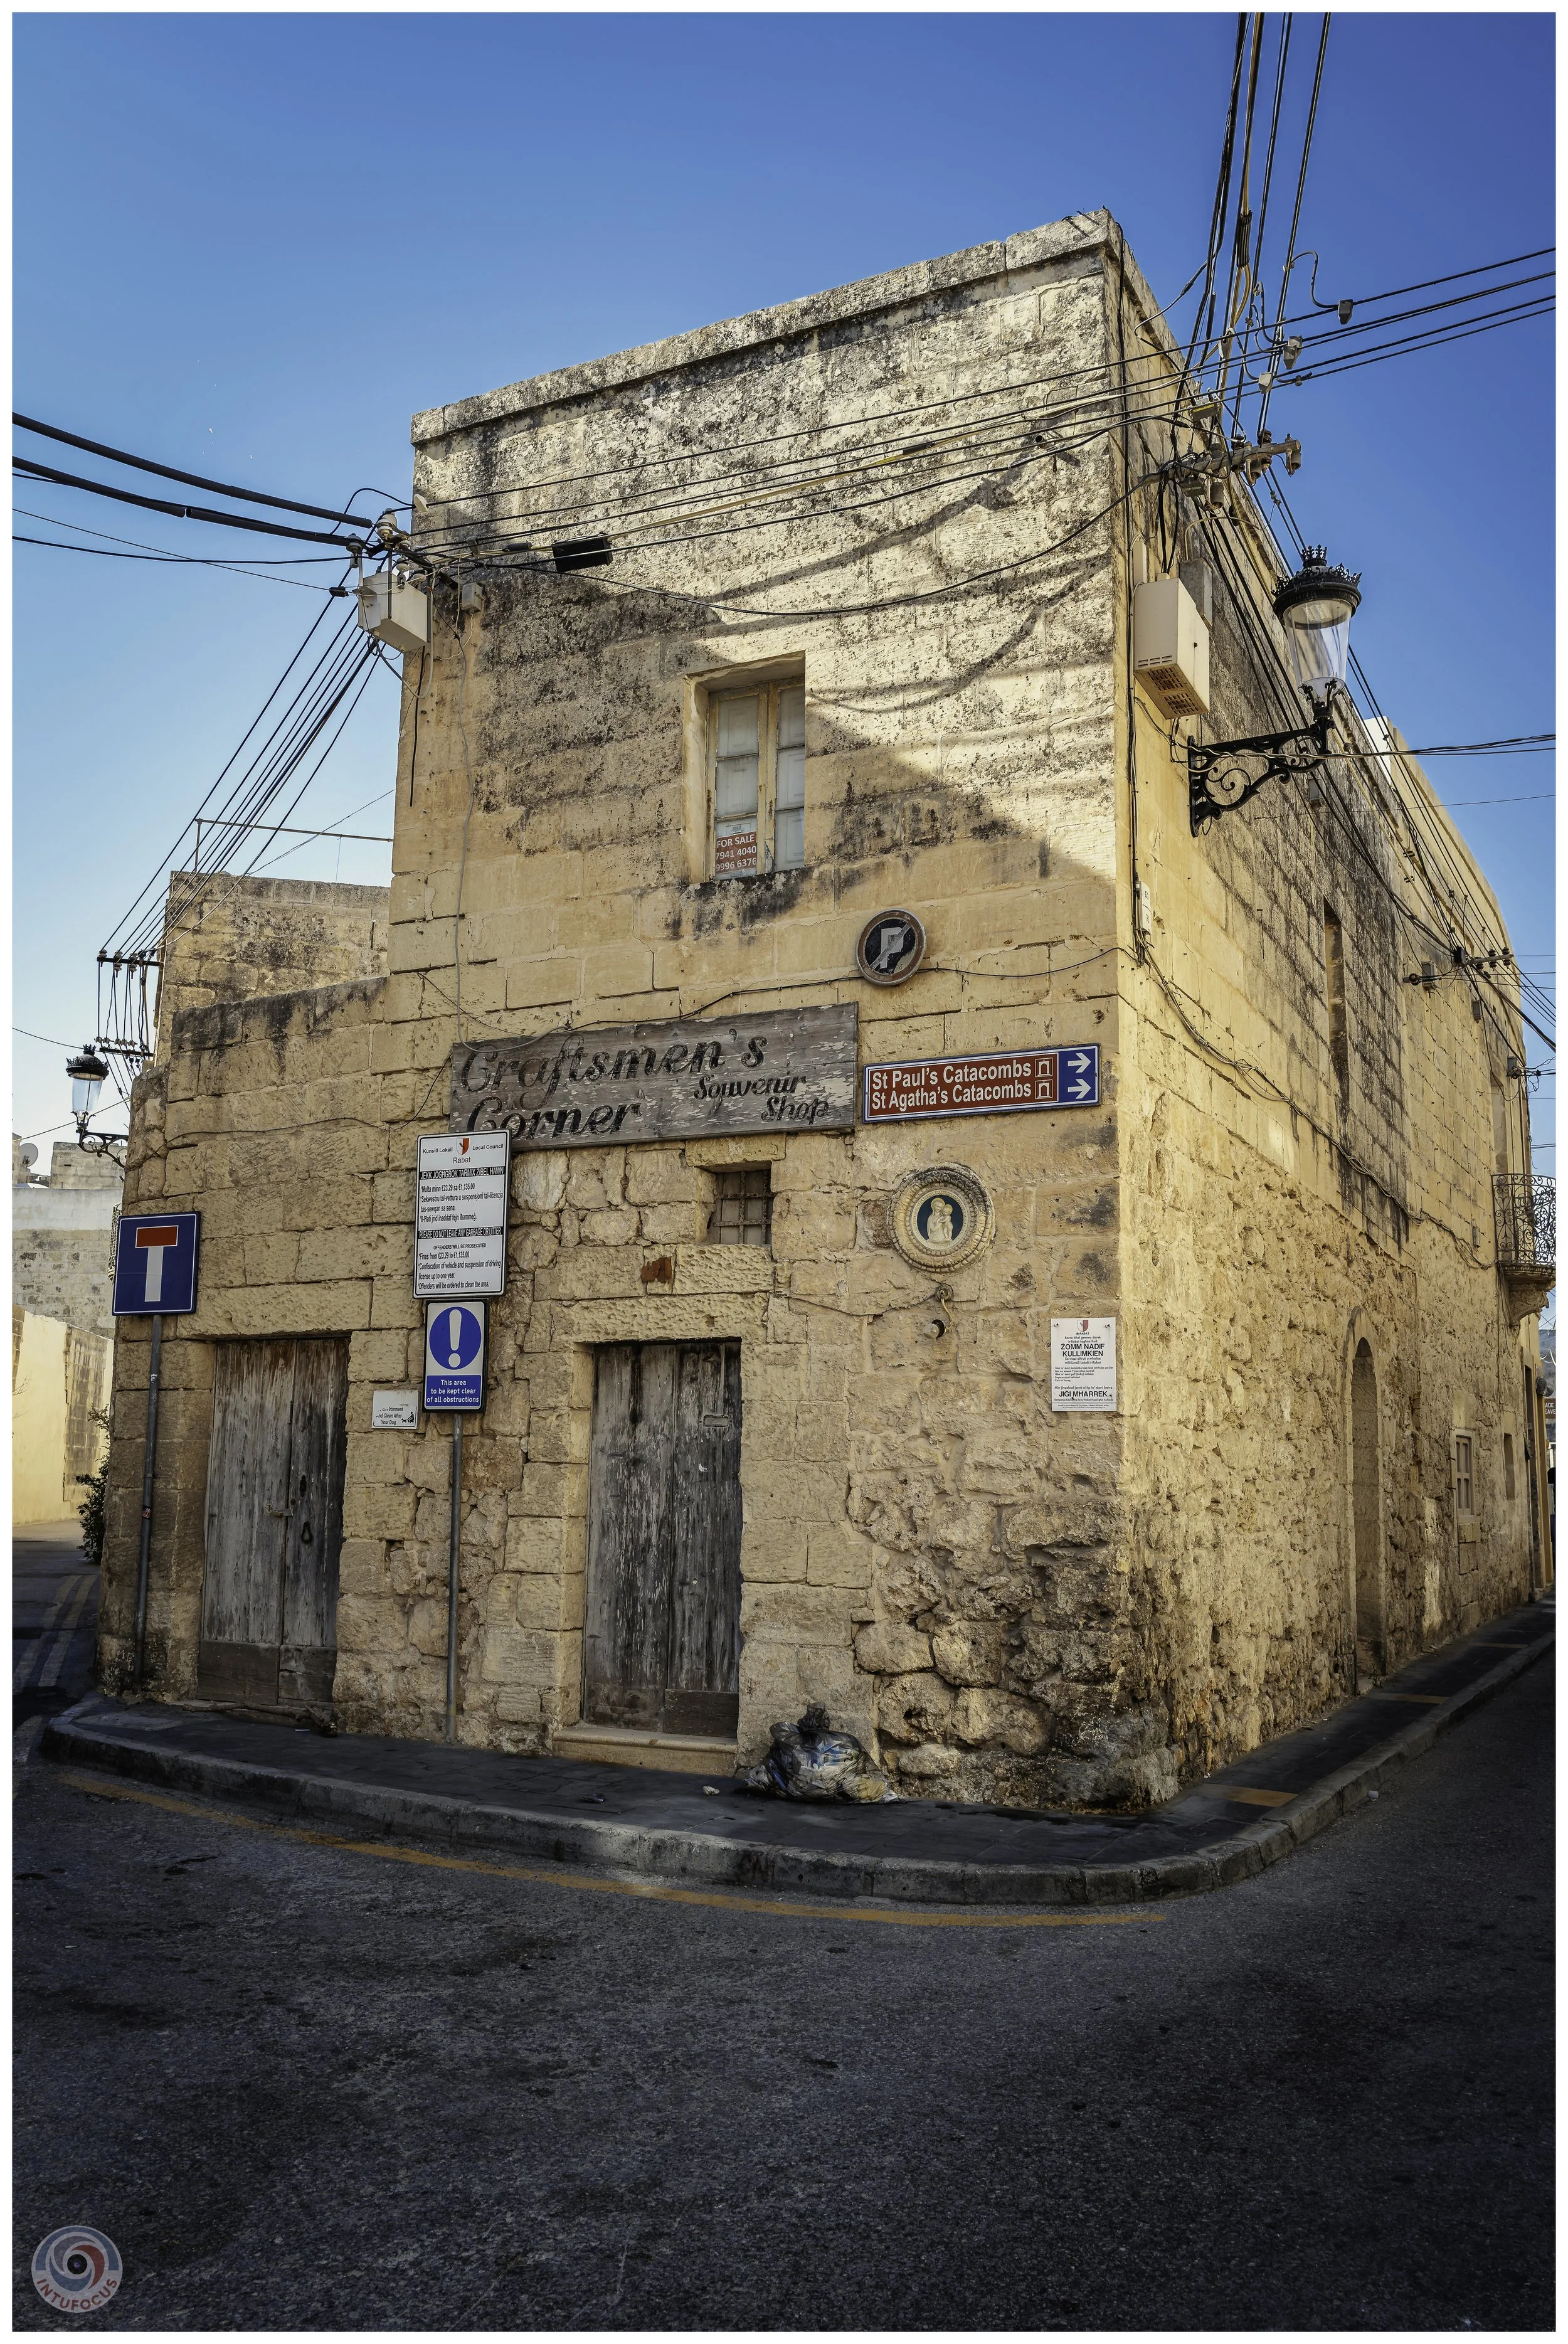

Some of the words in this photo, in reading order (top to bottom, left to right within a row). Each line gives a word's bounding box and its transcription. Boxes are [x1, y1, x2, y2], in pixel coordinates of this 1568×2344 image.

[717, 839, 733, 848] FOR
[734, 834, 755, 845] SALE
[716, 850, 734, 860] 7941
[737, 846, 757, 856] 4040
[716, 861, 734, 871] 9996
[737, 857, 757, 868] 6376
[461, 1028, 768, 1110] Craftsmen's
[872, 1071, 887, 1090] St
[893, 1068, 938, 1088] Paul's
[943, 1059, 1032, 1084] Catacombs
[694, 1074, 807, 1100] Souvenir
[872, 1091, 886, 1110] St
[889, 1086, 948, 1112] Agatha's
[952, 1080, 1032, 1103] Catacombs
[761, 1096, 830, 1125] Shop
[467, 1096, 642, 1140] Corner
[421, 1171, 432, 1179] JEKK
[489, 1167, 504, 1175] HAWN
[458, 1183, 475, 1192] €1,135.00
[462, 1193, 484, 1201] sospensjoni
[420, 1231, 432, 1239] PLEASE
[433, 1230, 439, 1238] DO
[489, 1227, 501, 1235] LITTER
[453, 1251, 469, 1260] €1,135.00
[489, 1260, 501, 1268] driving
